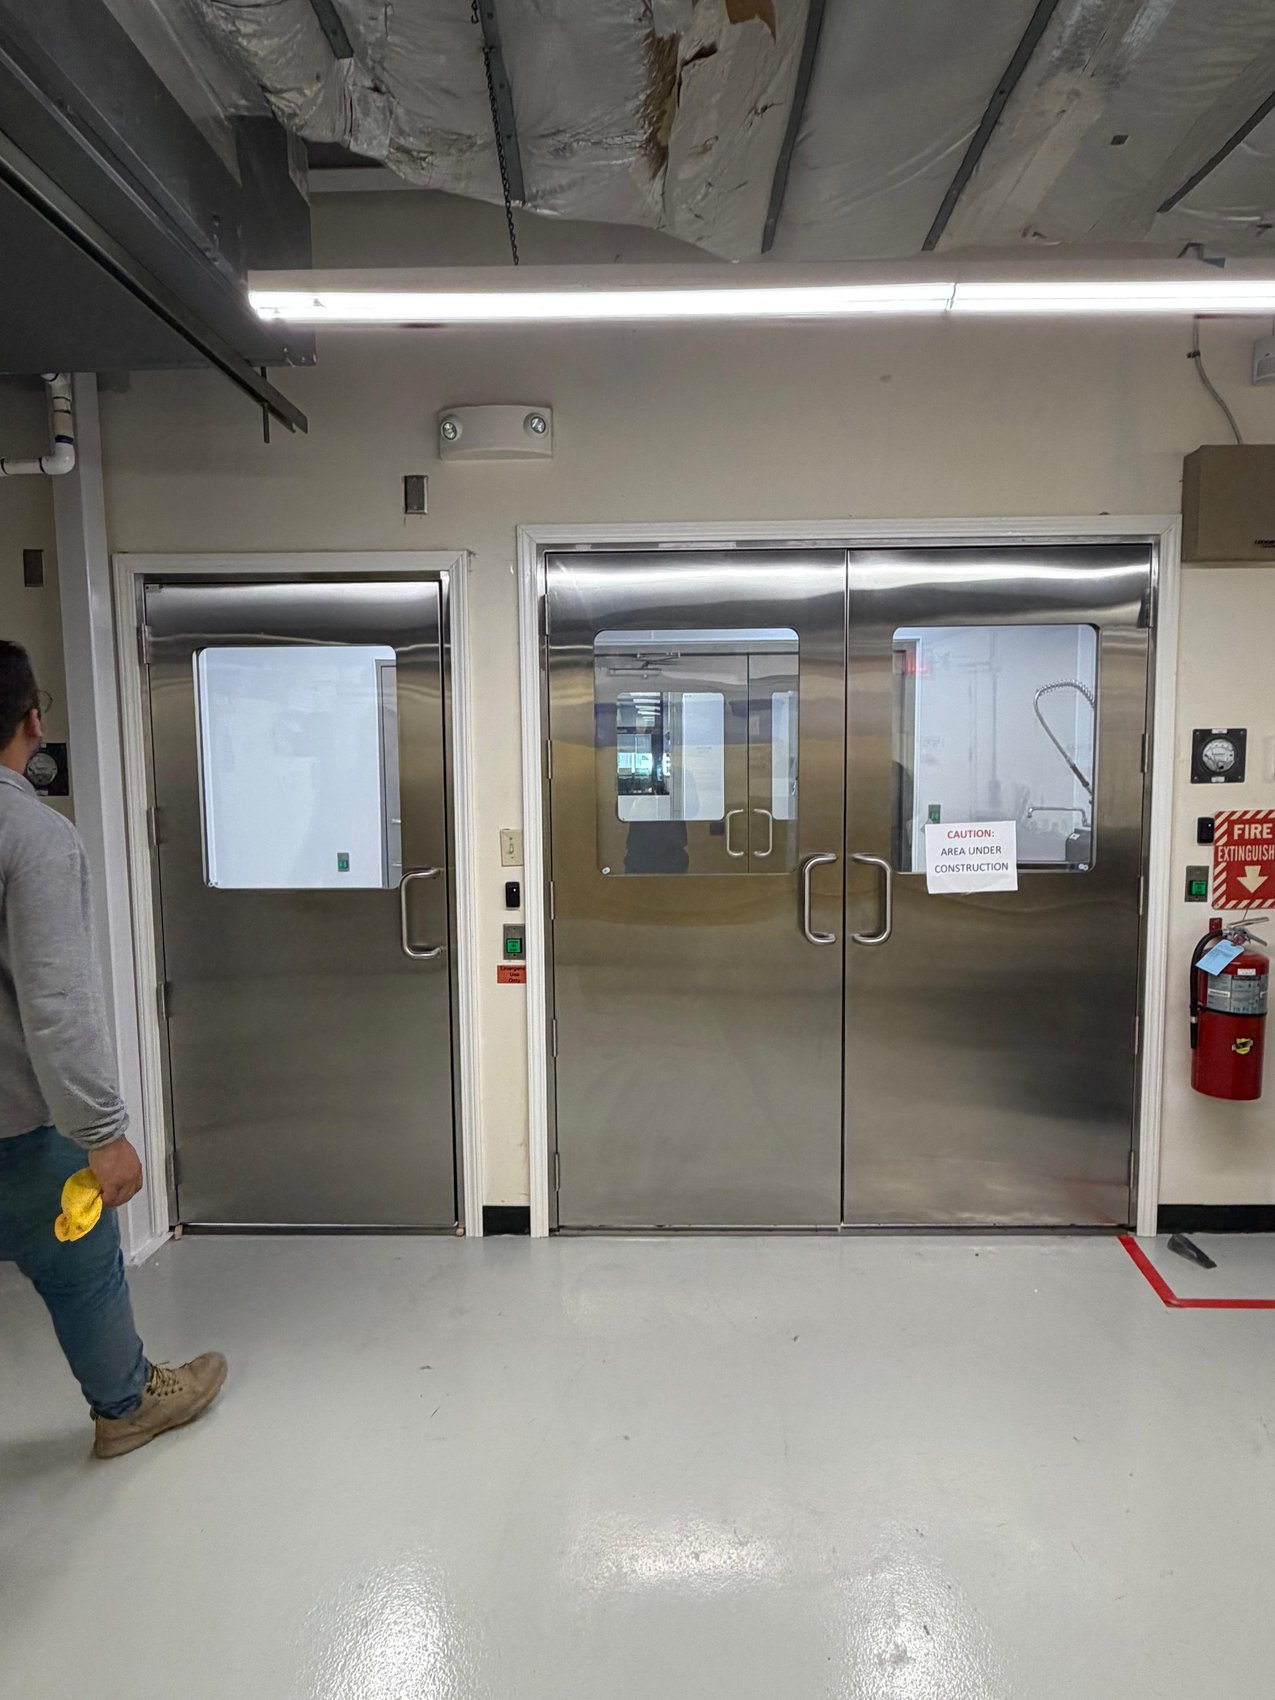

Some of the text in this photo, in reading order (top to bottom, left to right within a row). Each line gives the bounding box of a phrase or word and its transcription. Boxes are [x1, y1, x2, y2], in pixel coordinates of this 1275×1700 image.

[947, 829, 995, 839] CAUTION:
[1233, 823, 1273, 840] FIRE
[940, 845, 1002, 856] AREA UNDER
[1217, 844, 1275, 862] EXTINGUISH
[934, 862, 1009, 874] CONSTRUCTION
